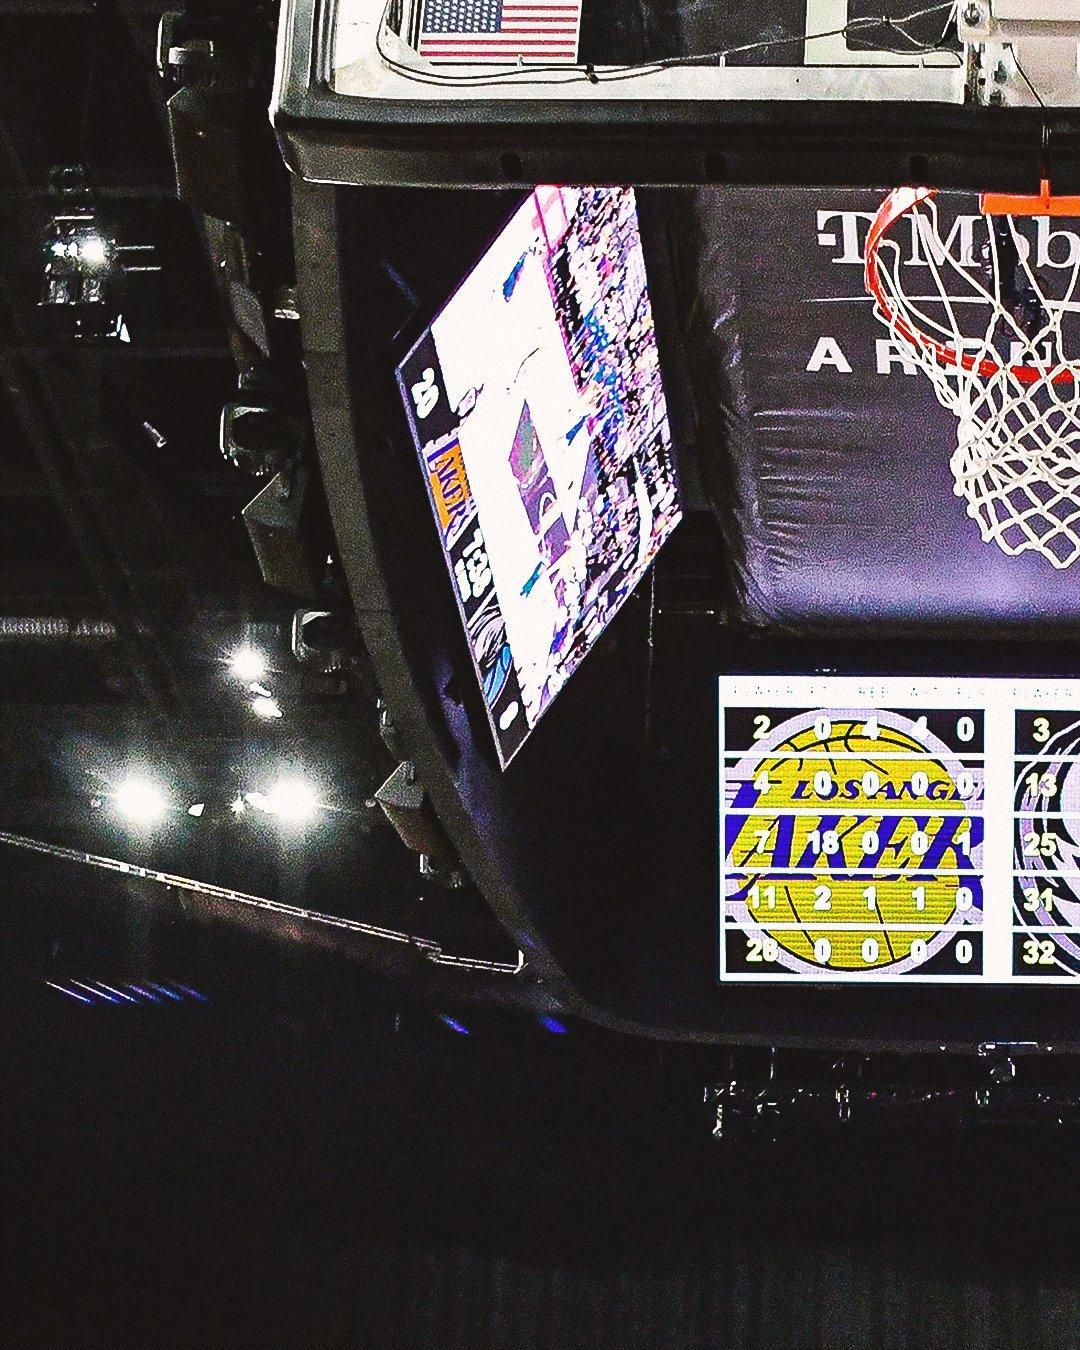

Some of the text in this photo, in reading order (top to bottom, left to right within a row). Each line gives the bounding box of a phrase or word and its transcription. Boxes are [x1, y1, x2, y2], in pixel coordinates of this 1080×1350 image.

[753, 715, 771, 740] 2
[813, 715, 832, 740] 0
[861, 715, 881, 740] 4
[956, 716, 975, 741] 0
[1032, 718, 1050, 743] 3
[753, 771, 975, 797] 4 0 0 0 0
[1025, 772, 1057, 798] 13
[754, 830, 971, 855] 7 18 0 0 1
[1023, 832, 1057, 857] 25
[752, 885, 973, 911] 11 2 1 1 0
[1023, 888, 1053, 913] 31
[813, 937, 832, 963] 0
[861, 937, 880, 963] 0
[910, 938, 929, 964] 0
[955, 938, 973, 964] 0
[1022, 940, 1055, 965] 32
